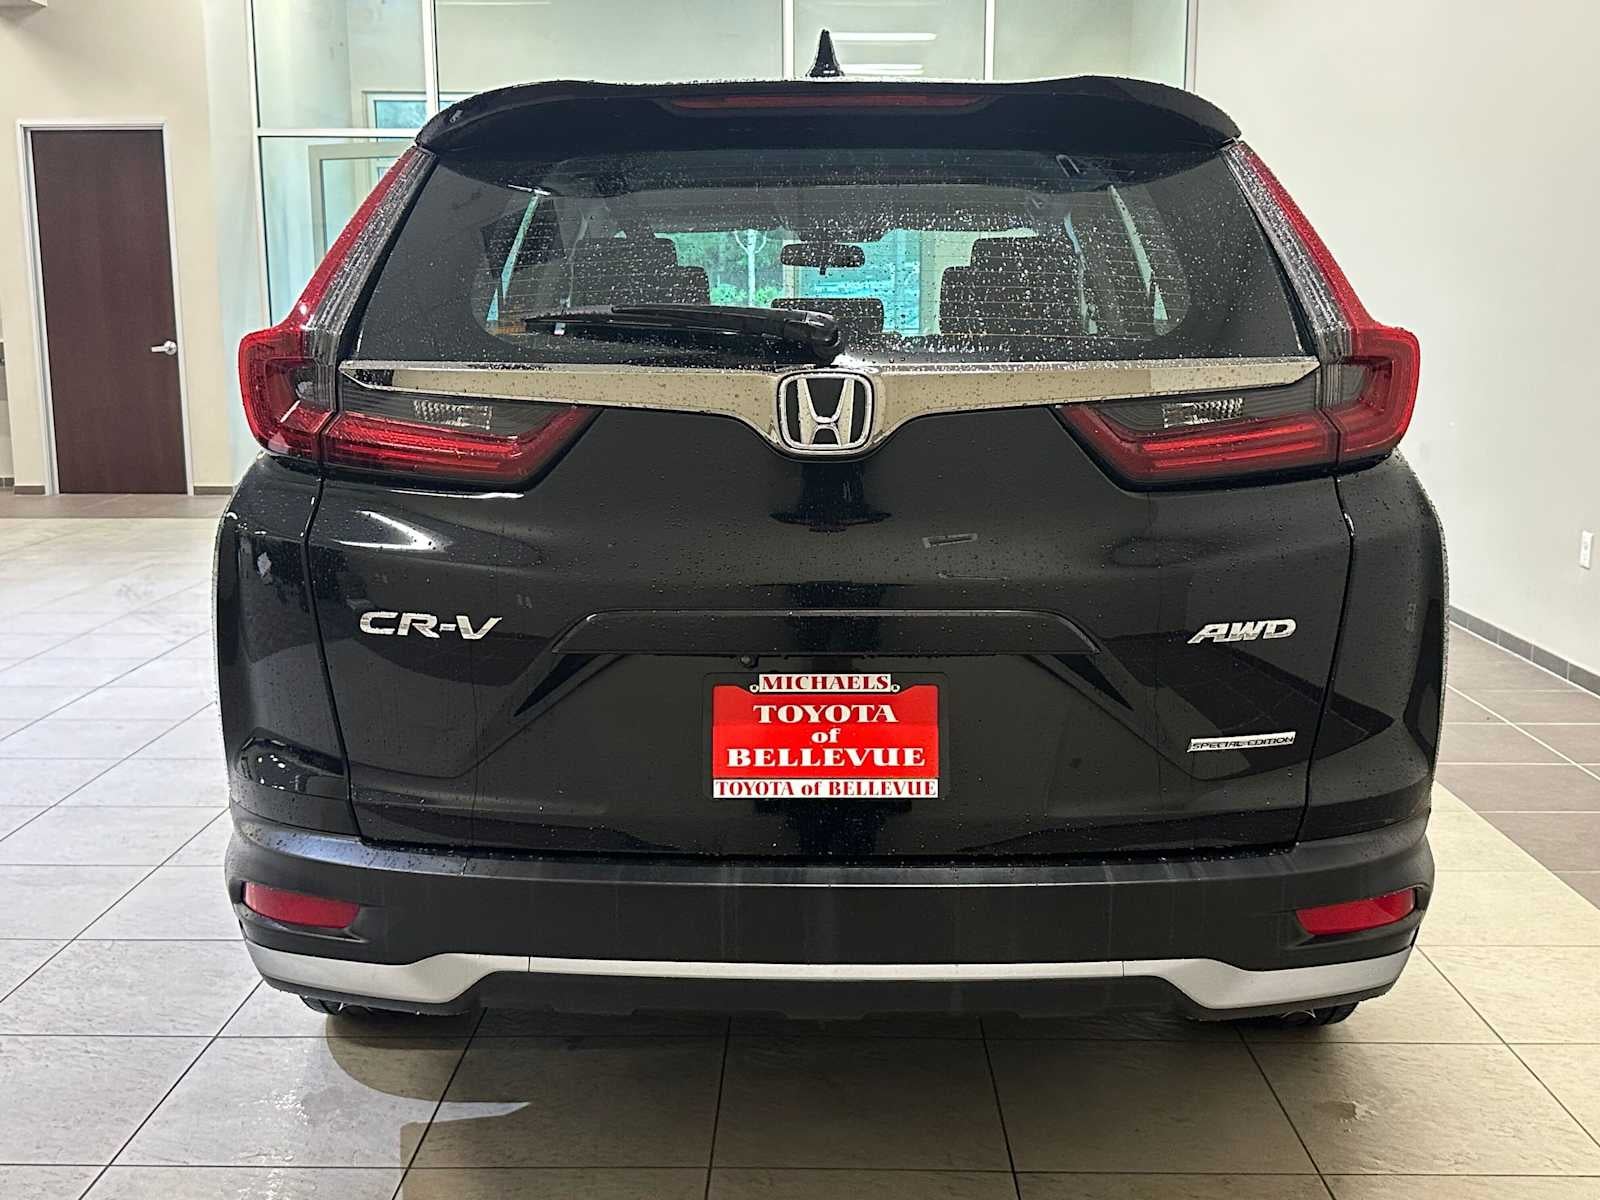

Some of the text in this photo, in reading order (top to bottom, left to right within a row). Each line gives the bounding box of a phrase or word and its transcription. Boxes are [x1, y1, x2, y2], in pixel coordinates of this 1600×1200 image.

[359, 611, 503, 640] CR-V
[1187, 619, 1297, 644] AWD
[762, 675, 889, 690] MICHAELS
[752, 704, 898, 724] TOYOTA
[811, 727, 841, 744] of
[1191, 736, 1294, 750] SPECIAL EDITION
[727, 748, 926, 767] BELLEVUE
[715, 781, 936, 796] TOYOTA of BELLEVUE
